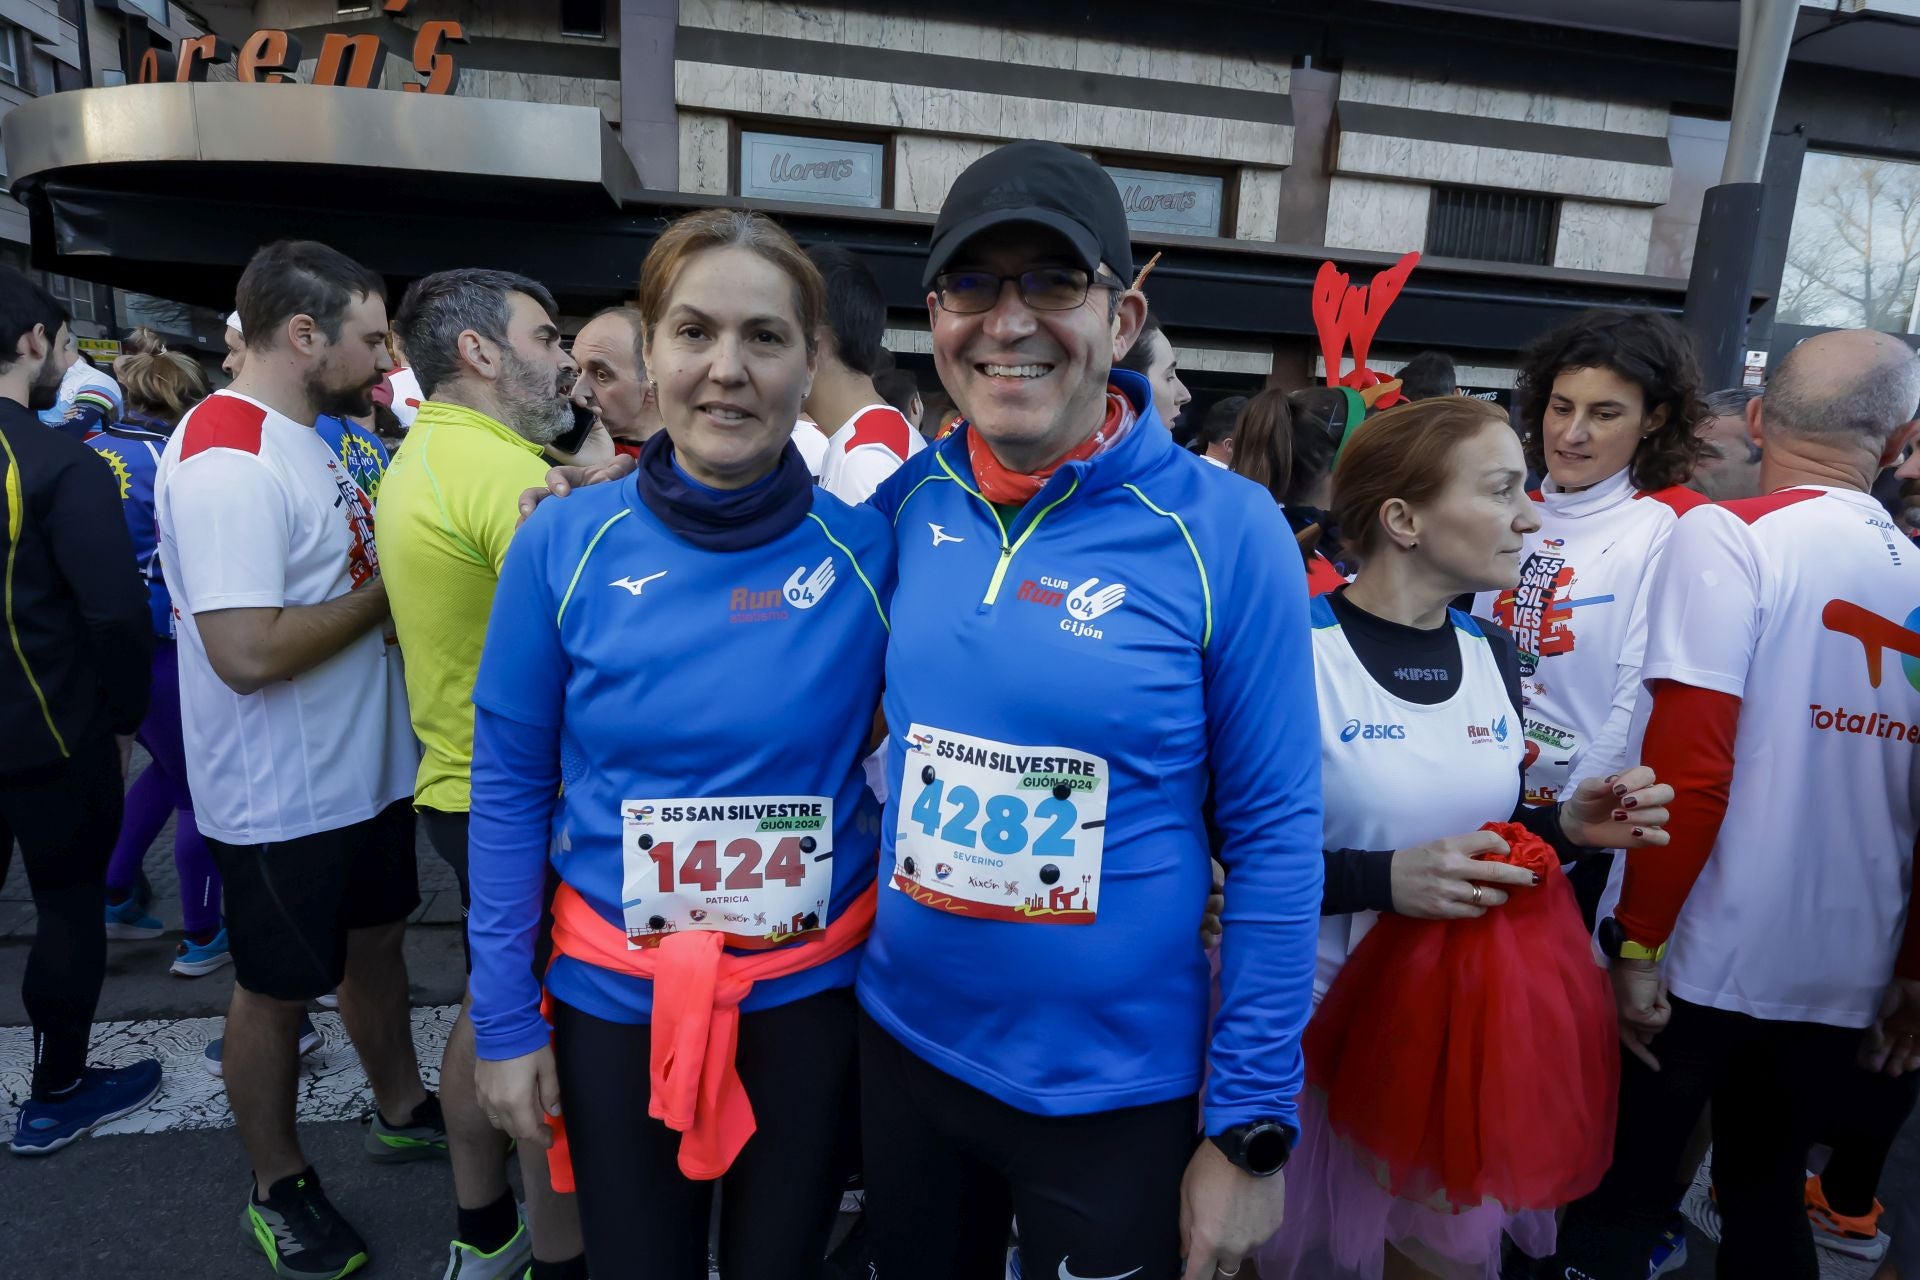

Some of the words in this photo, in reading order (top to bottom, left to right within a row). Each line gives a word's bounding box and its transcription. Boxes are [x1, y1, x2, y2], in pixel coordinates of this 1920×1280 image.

[1536, 557, 1563, 575] 55
[1040, 576, 1069, 590] CLUB
[1522, 567, 1553, 589] SAN
[730, 587, 782, 612] Run
[788, 586, 815, 604] 04
[1017, 580, 1064, 608] Run
[1070, 598, 1094, 617] 04
[1515, 585, 1543, 607] SIL
[1513, 606, 1541, 629] VES
[1060, 619, 1104, 640] Gijón
[1510, 625, 1540, 657] TRE
[1362, 724, 1406, 740] asics
[1467, 725, 1490, 738] Run
[1809, 704, 1920, 744] TotalEne
[937, 739, 955, 759] 55
[955, 744, 988, 768] SAN
[988, 751, 1096, 778] SILVESTRE
[1022, 774, 1059, 789] GIJÓN
[660, 806, 684, 822] 55
[685, 805, 724, 822] SAN
[727, 803, 822, 820] SILVESTRE
[911, 778, 1078, 857] 4282
[760, 818, 792, 830] GIJÓN
[794, 819, 820, 830] 2024
[647, 836, 806, 893] 1424
[952, 850, 1004, 868] SEVERINO
[705, 895, 750, 905] PATRICIA
